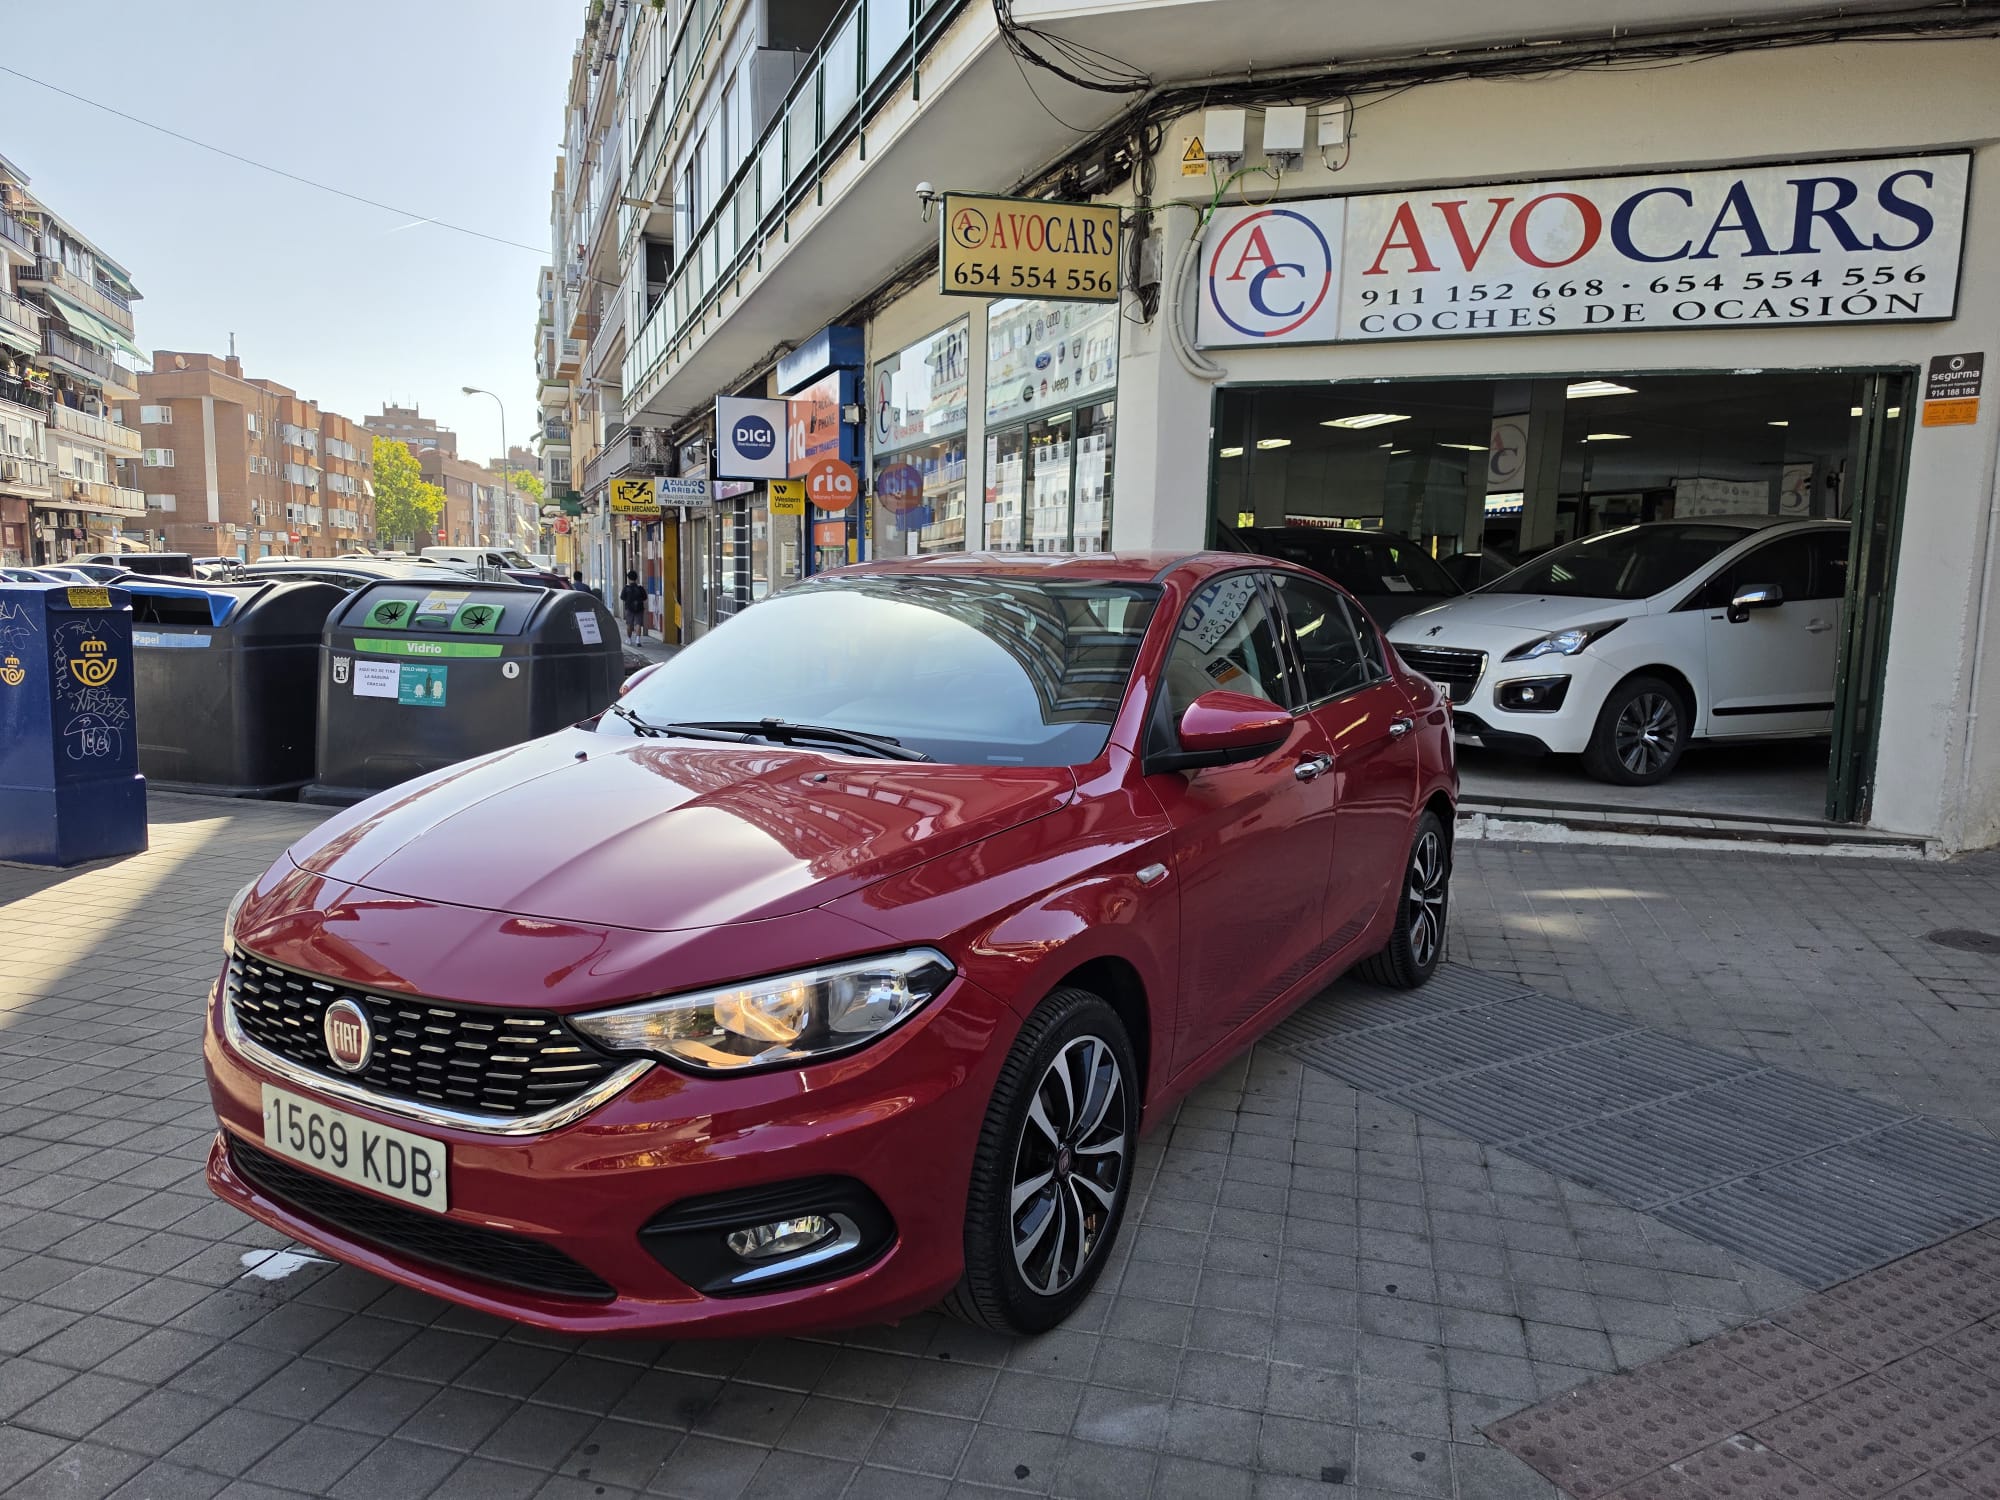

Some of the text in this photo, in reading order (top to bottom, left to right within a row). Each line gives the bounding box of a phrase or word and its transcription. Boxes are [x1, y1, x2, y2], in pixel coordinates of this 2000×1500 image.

[990, 211, 1113, 256] AVOCARS
[1363, 169, 1934, 275] AVOCARS
[954, 261, 1112, 293] 654 554 556
[1361, 264, 1926, 307] 911 152 668 654 554 556
[1359, 288, 1924, 333] COCHES DE OCASIÓN
[1931, 370, 1980, 382] segurma
[1931, 389, 1945, 397] 914
[737, 428, 771, 443] DIGI
[813, 465, 852, 492] ria
[133, 634, 160, 645] Papel
[407, 642, 442, 654] Vidrio
[333, 1019, 360, 1055] FIAT
[272, 1098, 433, 1198] 1569 KDB
